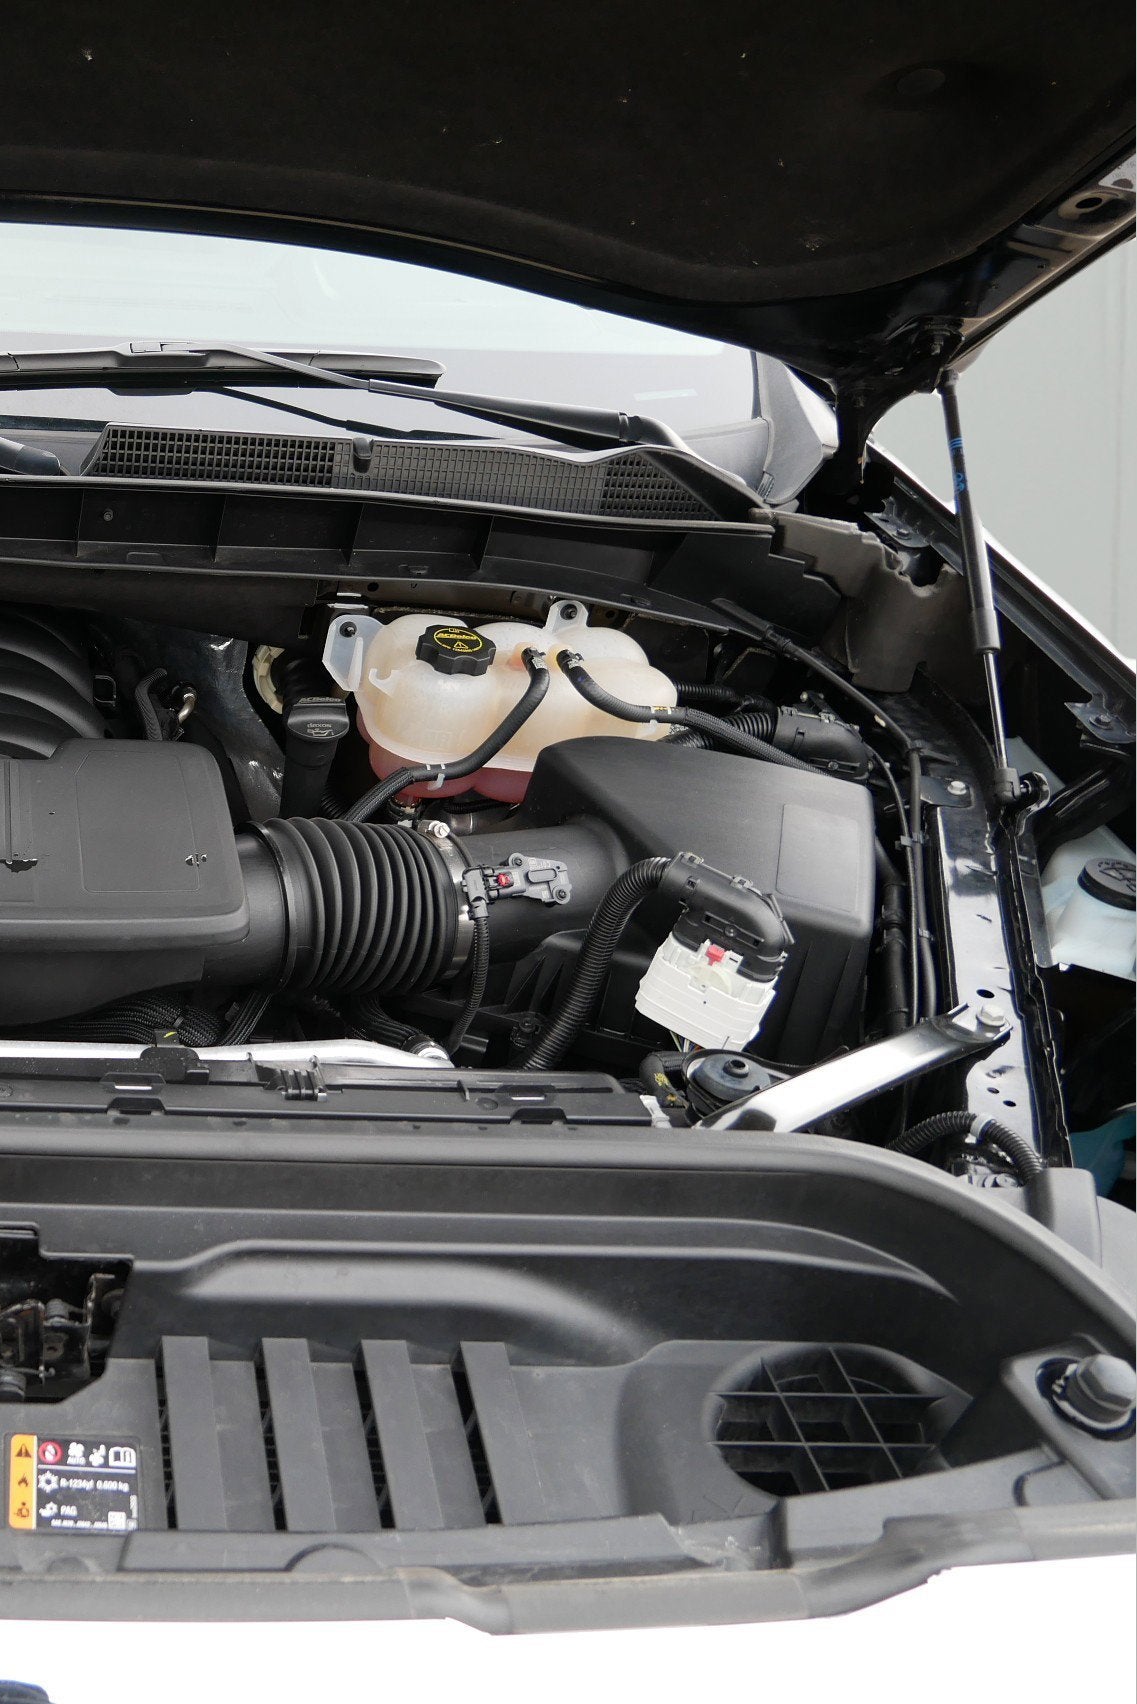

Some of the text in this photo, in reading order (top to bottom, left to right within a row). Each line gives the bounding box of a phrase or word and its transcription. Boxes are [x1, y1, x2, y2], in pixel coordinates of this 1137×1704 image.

[298, 696, 341, 704] ACDelco
[60, 1478, 94, 1490] R-1234yf
[60, 1505, 78, 1517] PAG
